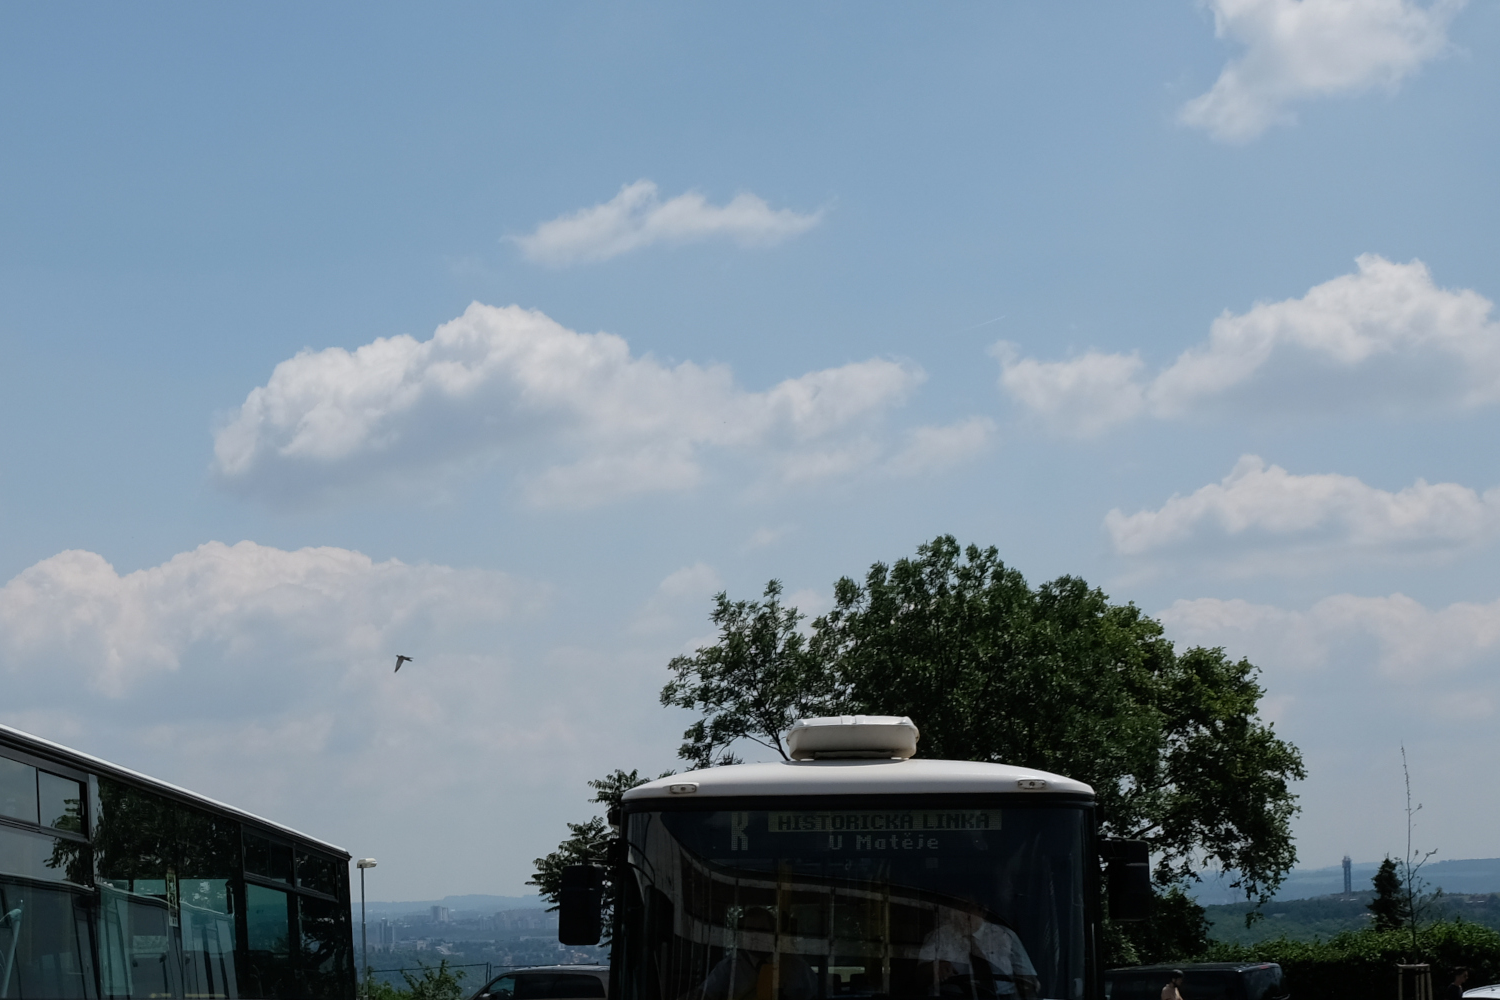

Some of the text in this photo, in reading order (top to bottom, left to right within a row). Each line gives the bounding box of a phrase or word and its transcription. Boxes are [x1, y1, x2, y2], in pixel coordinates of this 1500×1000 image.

[731, 812, 748, 850] K
[778, 810, 990, 831] HISTORICKÁ LINKA
[829, 832, 938, 850] U Matěje
